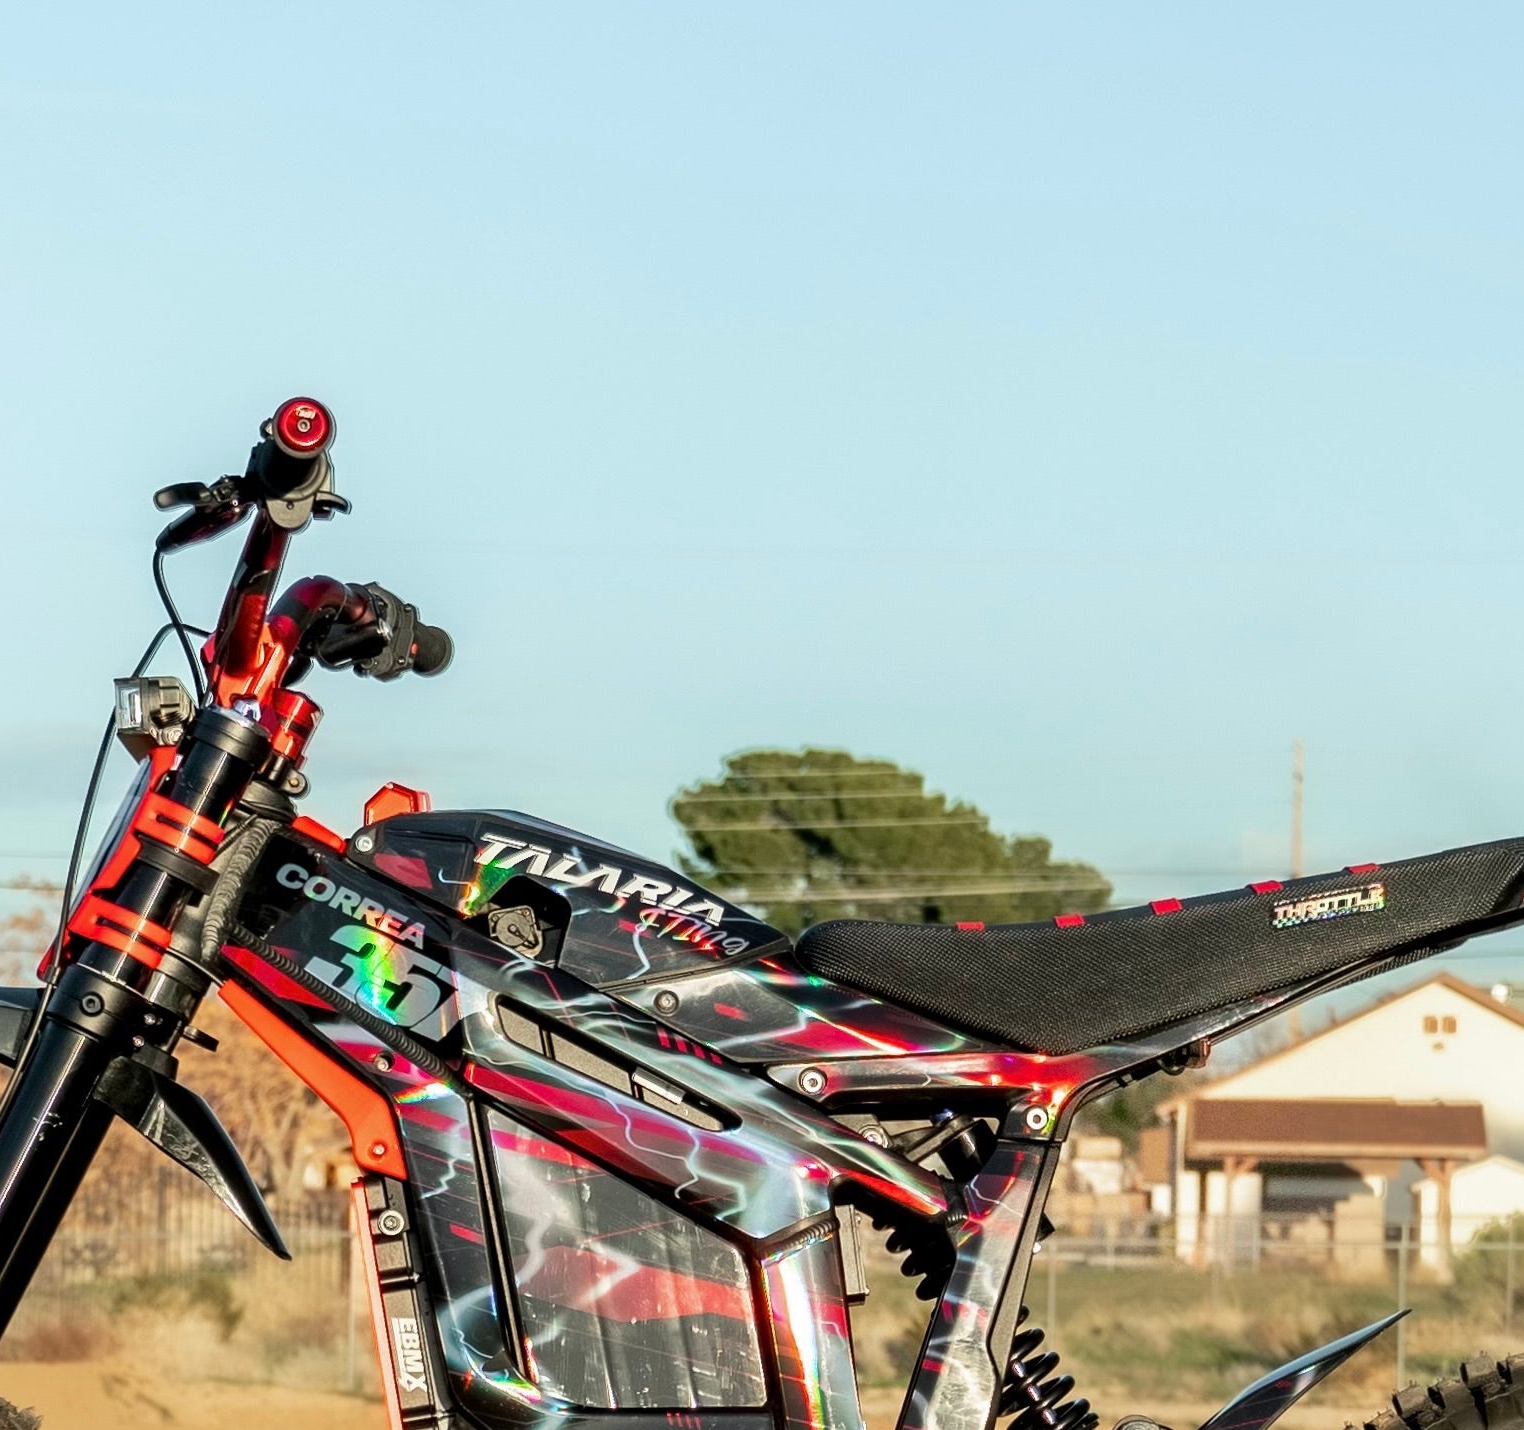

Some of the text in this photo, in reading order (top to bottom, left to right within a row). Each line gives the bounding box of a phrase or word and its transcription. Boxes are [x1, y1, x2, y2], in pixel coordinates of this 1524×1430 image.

[276, 863, 426, 950] CORREA
[474, 833, 726, 926] TALARIA
[392, 1317, 429, 1394] EBMX
